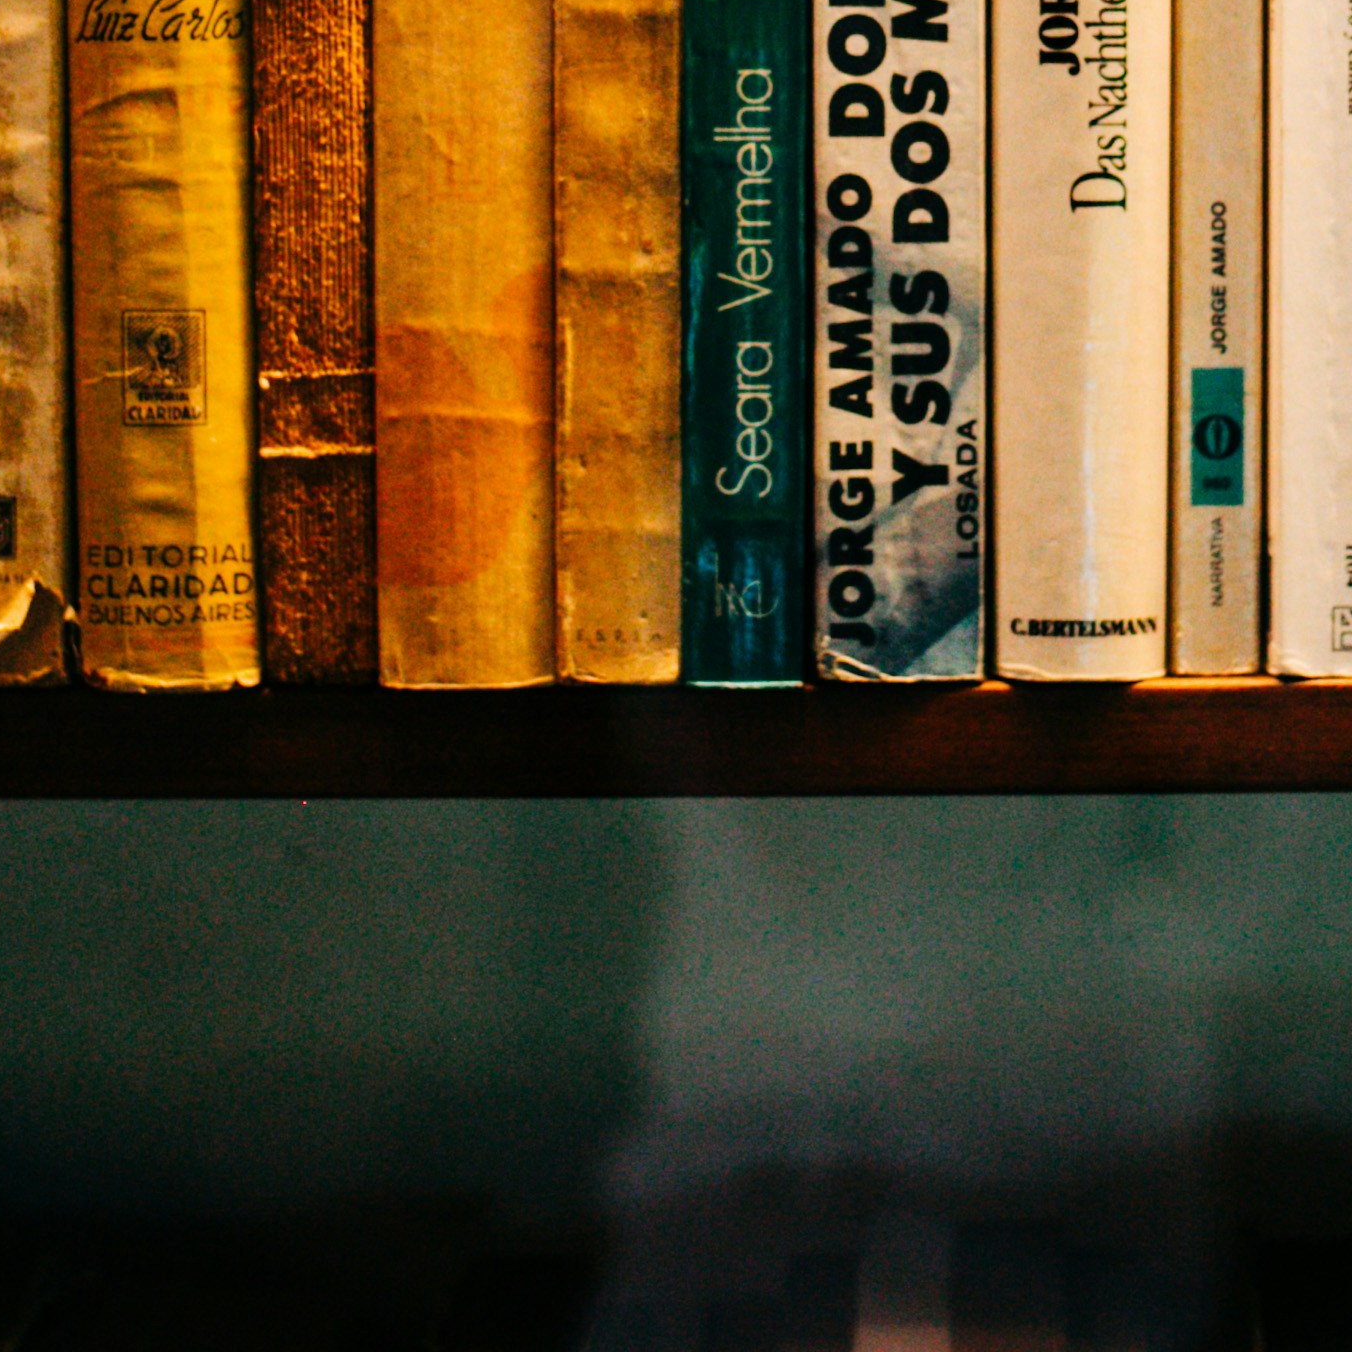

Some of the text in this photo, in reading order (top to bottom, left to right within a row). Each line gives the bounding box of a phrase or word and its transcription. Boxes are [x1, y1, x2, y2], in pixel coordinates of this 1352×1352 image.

[713, 68, 774, 312] Vermelha
[889, 68, 951, 245] DOS
[1070, 133, 1128, 214] Das
[826, 172, 874, 419] AMADO
[889, 268, 952, 427] SUS
[1210, 201, 1228, 355] JORGE AMADO
[715, 340, 774, 499] Seara
[890, 448, 951, 506] Y
[955, 417, 978, 560] LOSADA
[86, 544, 254, 569] EDITORIAL
[86, 572, 255, 601] CLARIDAD
[87, 601, 255, 627] BUENOS AIRES
[827, 439, 877, 647] JORGE
[1209, 516, 1225, 607] NARRATIVA
